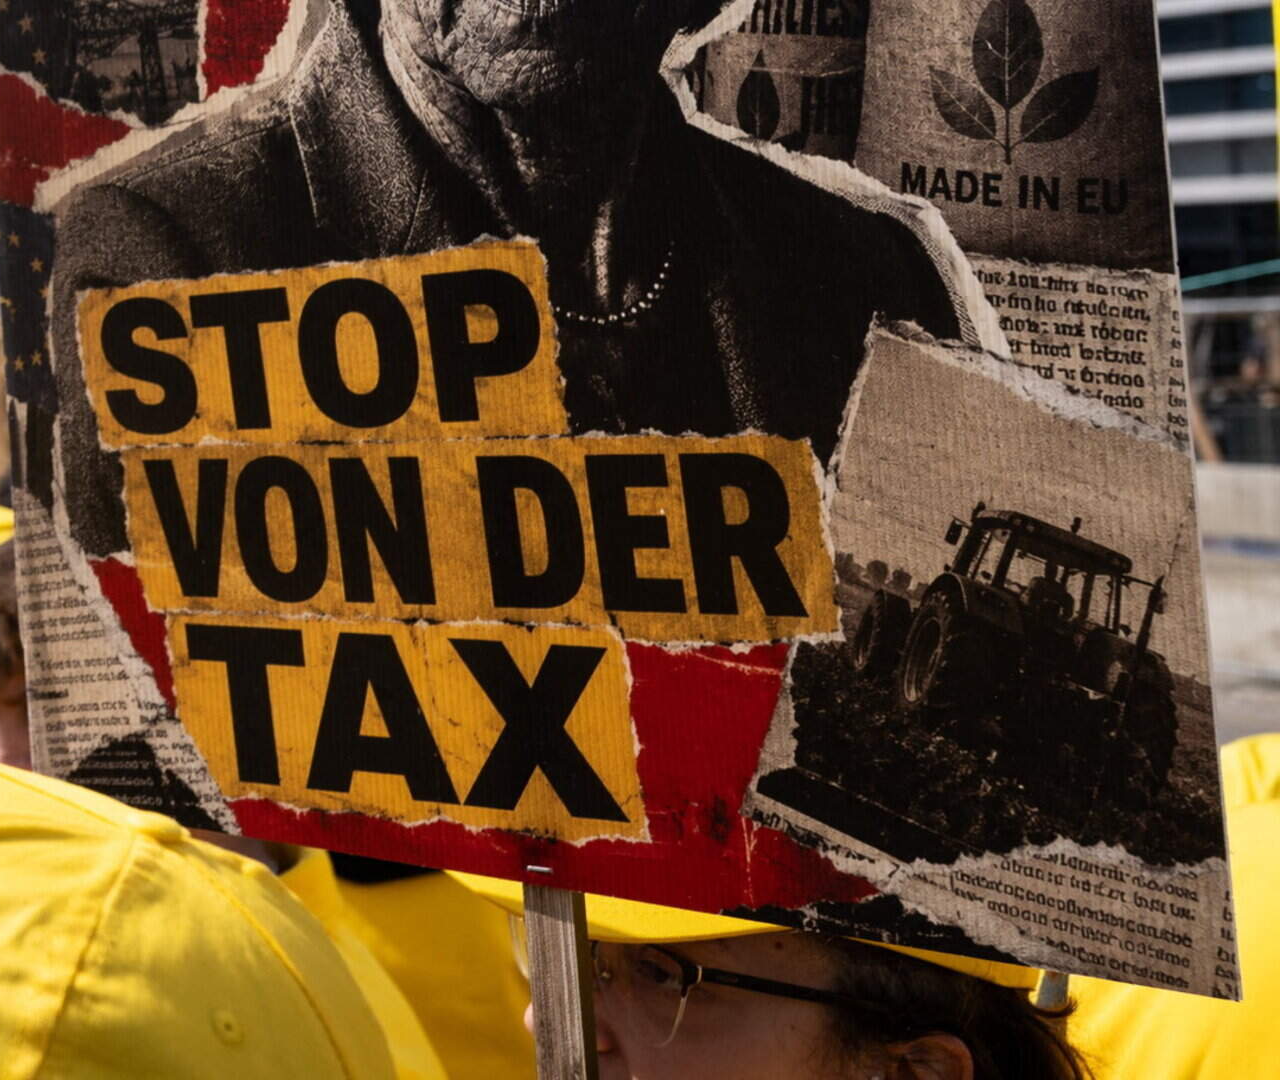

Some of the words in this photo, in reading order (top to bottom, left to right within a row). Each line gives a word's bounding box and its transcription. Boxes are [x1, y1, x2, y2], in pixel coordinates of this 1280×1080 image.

[901, 161, 1003, 208] MADE
[1017, 175, 1061, 211] IN
[1077, 177, 1129, 215] EU
[100, 267, 541, 436] STOP
[143, 452, 433, 606] VON
[478, 451, 809, 618] DER
[185, 623, 631, 823] TAX
